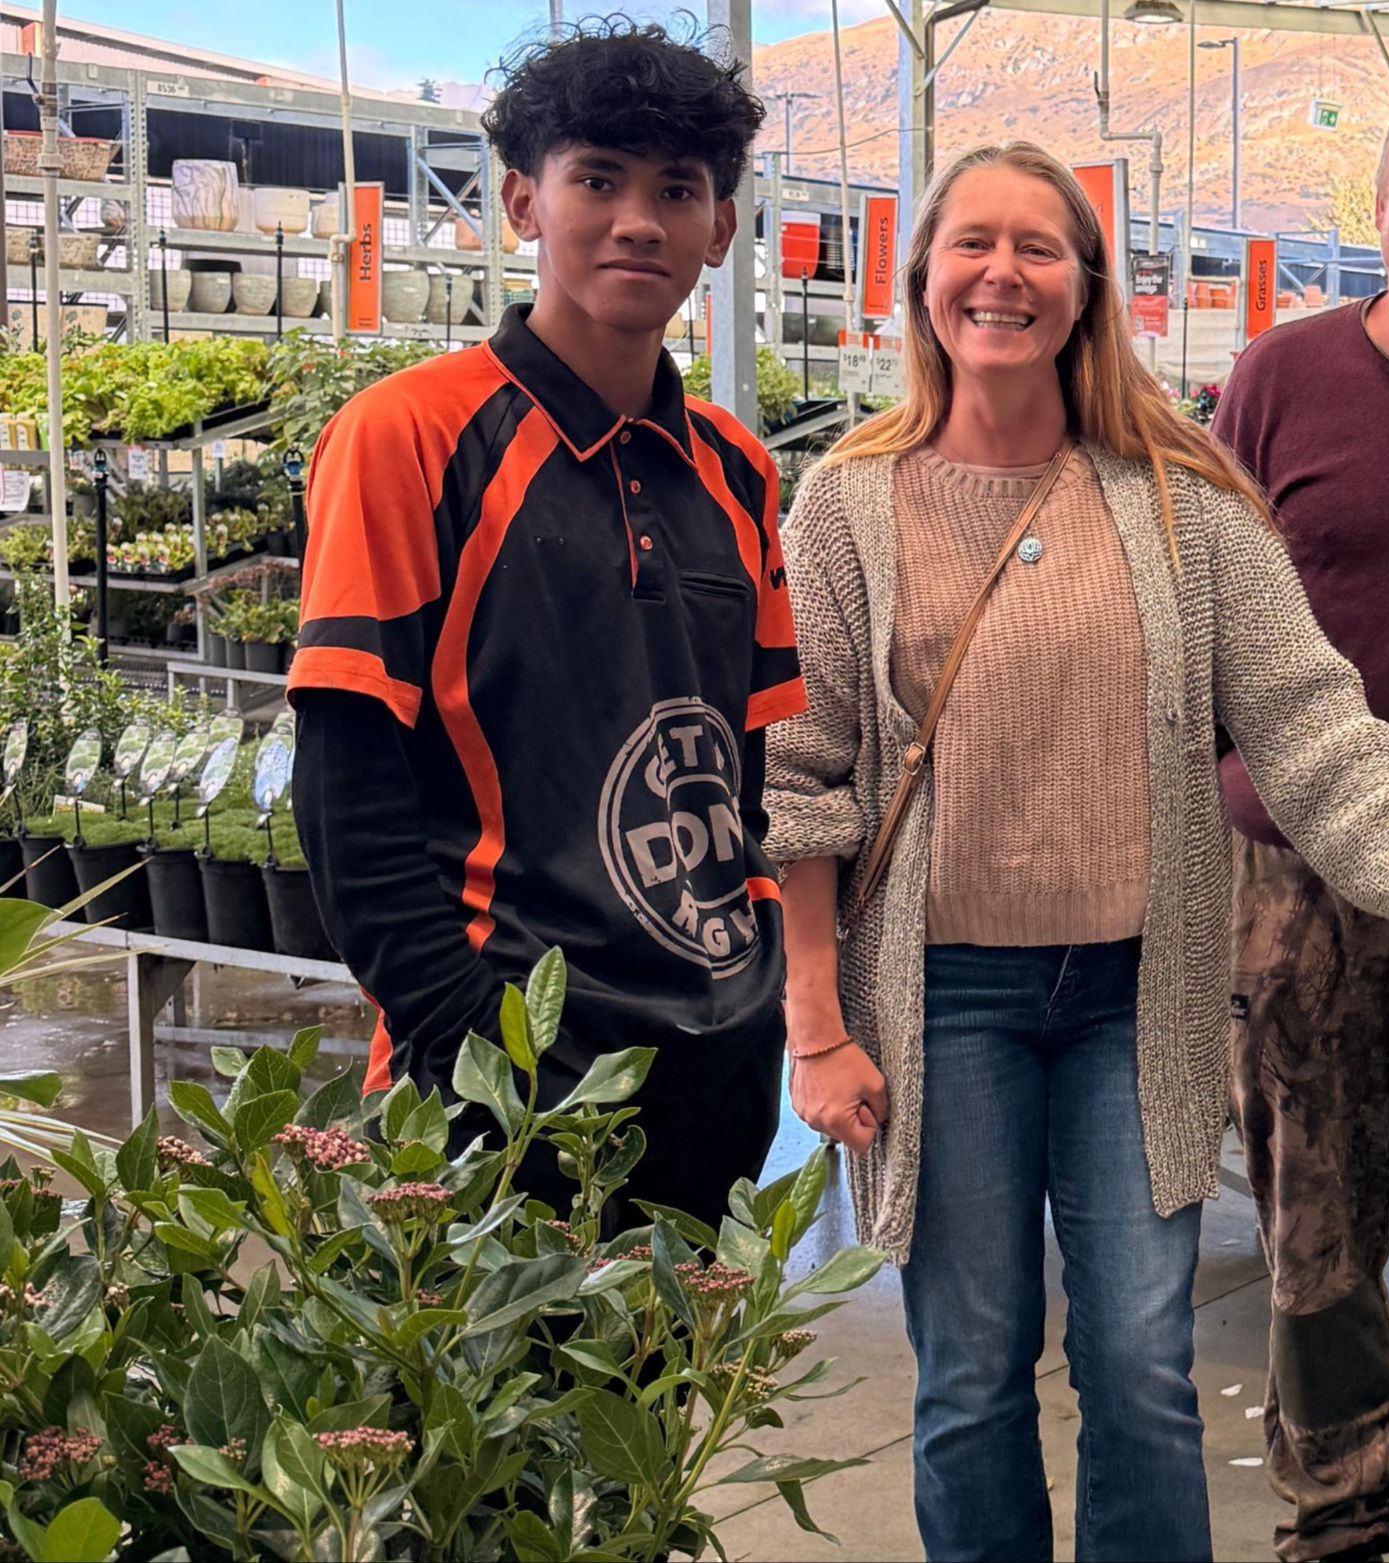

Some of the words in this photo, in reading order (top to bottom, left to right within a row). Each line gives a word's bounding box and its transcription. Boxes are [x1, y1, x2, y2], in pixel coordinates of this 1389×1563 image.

[359, 223, 372, 281] Herbs
[874, 216, 889, 285] Flowers
[1255, 259, 1267, 312] Grasses
